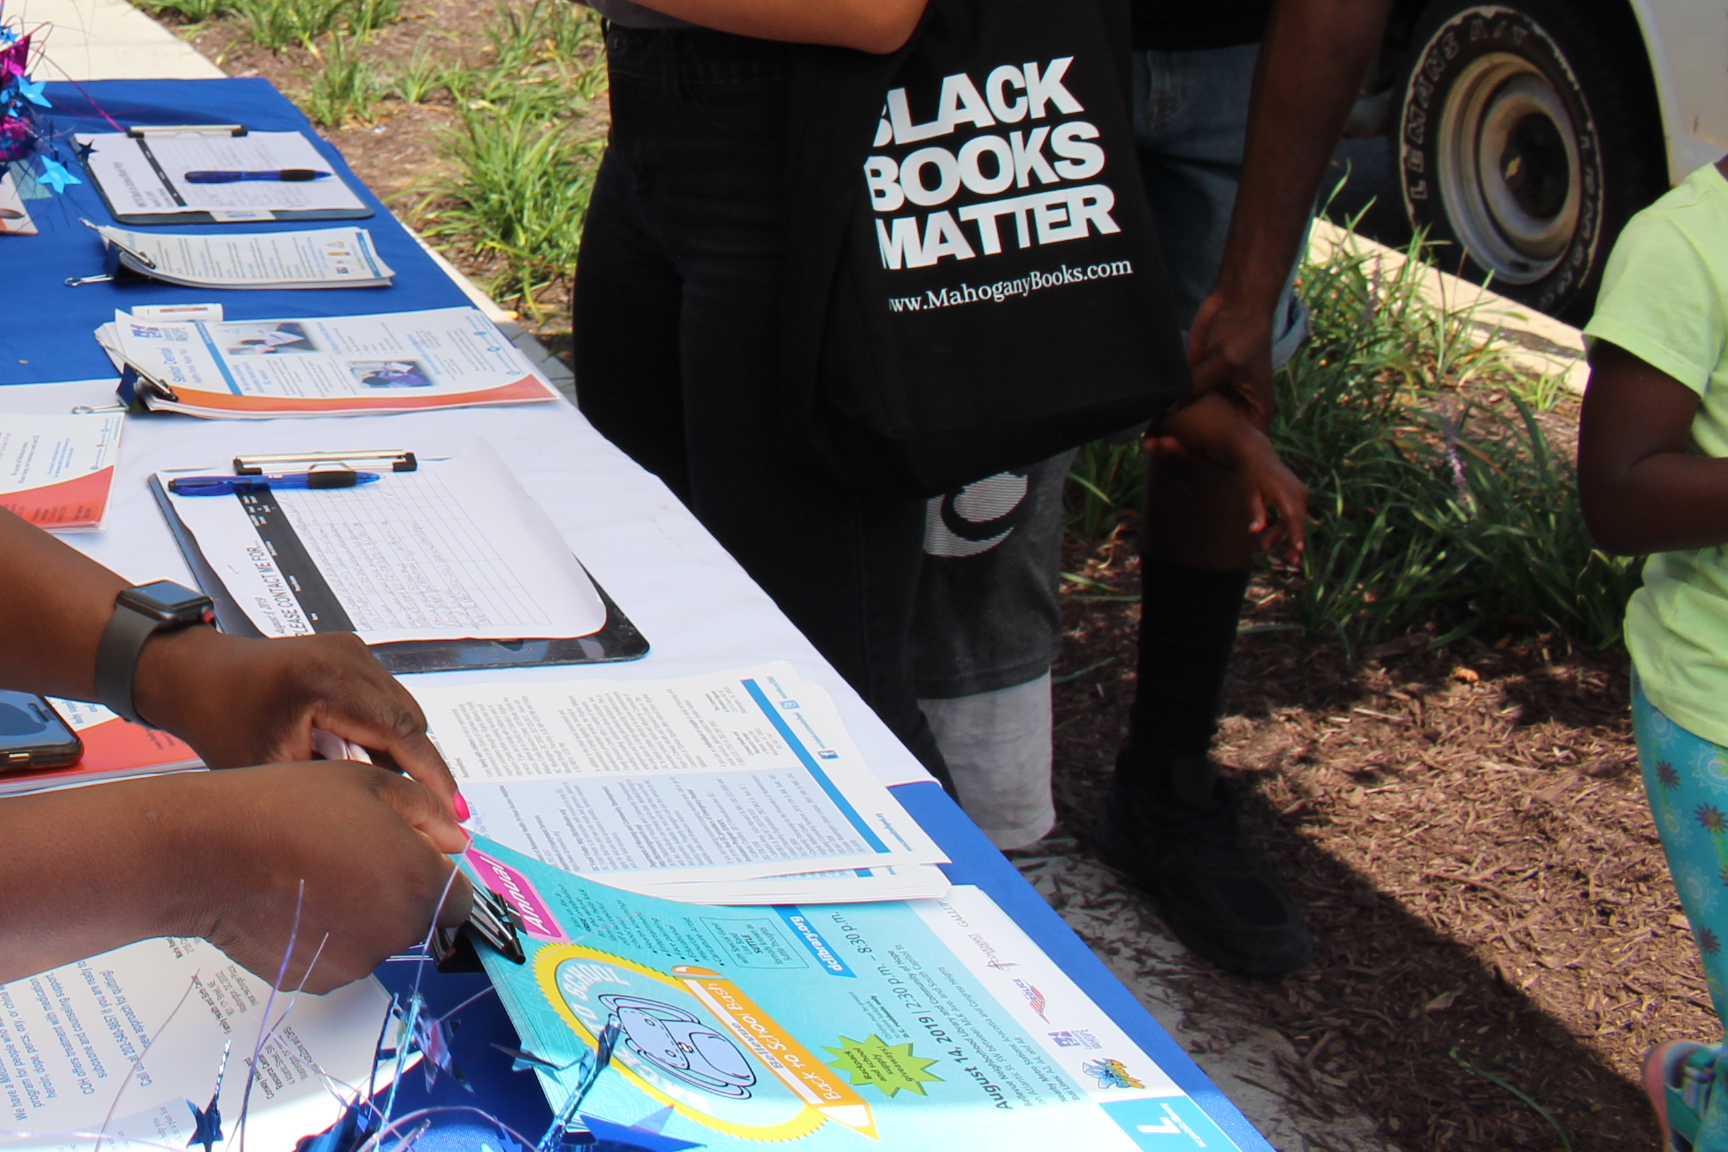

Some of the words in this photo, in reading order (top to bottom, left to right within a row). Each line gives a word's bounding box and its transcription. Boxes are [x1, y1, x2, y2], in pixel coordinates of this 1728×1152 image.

[1403, 31, 1462, 200] LEMANS
[863, 121, 1105, 212] BOOKS
[875, 184, 1121, 270] MATTER
[254, 562, 272, 572] ME
[261, 574, 292, 607] CONTACT
[281, 609, 310, 636] PLEASE
[479, 856, 551, 934] Annual
[831, 911, 857, 931] p.m.
[741, 934, 762, 953] SUTTLE
[790, 916, 842, 971] dclibrary.org
[845, 933, 872, 953] 8:30
[887, 950, 903, 964] Hope
[899, 951, 921, 970] Capitol
[80, 968, 96, 985] ready
[99, 969, 122, 993] quitting!
[563, 964, 631, 1001] SCHOOL
[877, 963, 903, 984] p.m.
[0, 991, 14, 1008] china
[26, 977, 52, 1010] medication
[90, 985, 102, 995] are
[114, 993, 128, 1004] for
[707, 983, 743, 1010] Bash
[892, 987, 921, 1008] 2:30
[908, 973, 938, 1004] Community
[1012, 978, 1039, 1000] POLICE
[96, 995, 112, 1008] you
[45, 1011, 59, 1025] with
[58, 997, 82, 1031] counseling
[120, 1005, 144, 1033] approach
[736, 1013, 786, 1050] School
[918, 1016, 952, 1043] 2019
[947, 1017, 968, 1037] Library
[985, 1018, 1011, 1042] Anacostia
[20, 1032, 38, 1053] percs,
[52, 1025, 75, 1057] treatment
[74, 1032, 89, 1045] and
[731, 1022, 783, 1068] Bellevue
[969, 1026, 996, 1051] between
[4, 1043, 25, 1066] people
[30, 1053, 45, 1072] dope,
[83, 1045, 106, 1078] suboxone
[783, 1053, 804, 1068] to
[844, 1050, 872, 1079] Backpack
[852, 1047, 875, 1067] school
[872, 1053, 893, 1074] supply
[877, 1046, 916, 1081] giveaways!
[947, 1046, 968, 1063] 14,
[965, 1038, 1008, 1079] Neighborhood
[15, 1067, 27, 1077] for
[69, 1057, 86, 1076] offers
[39, 1073, 56, 1098] heroin,
[77, 1077, 94, 1094] COH
[135, 1071, 151, 1086] Call
[802, 1071, 839, 1099] Back
[964, 1066, 1011, 1108] August
[1011, 1072, 1037, 1094] Atlantic
[7, 1090, 21, 1107] have
[21, 1078, 44, 1107] program
[1005, 1080, 1032, 1106] Bellevue
[14, 1108, 27, 1120] We
